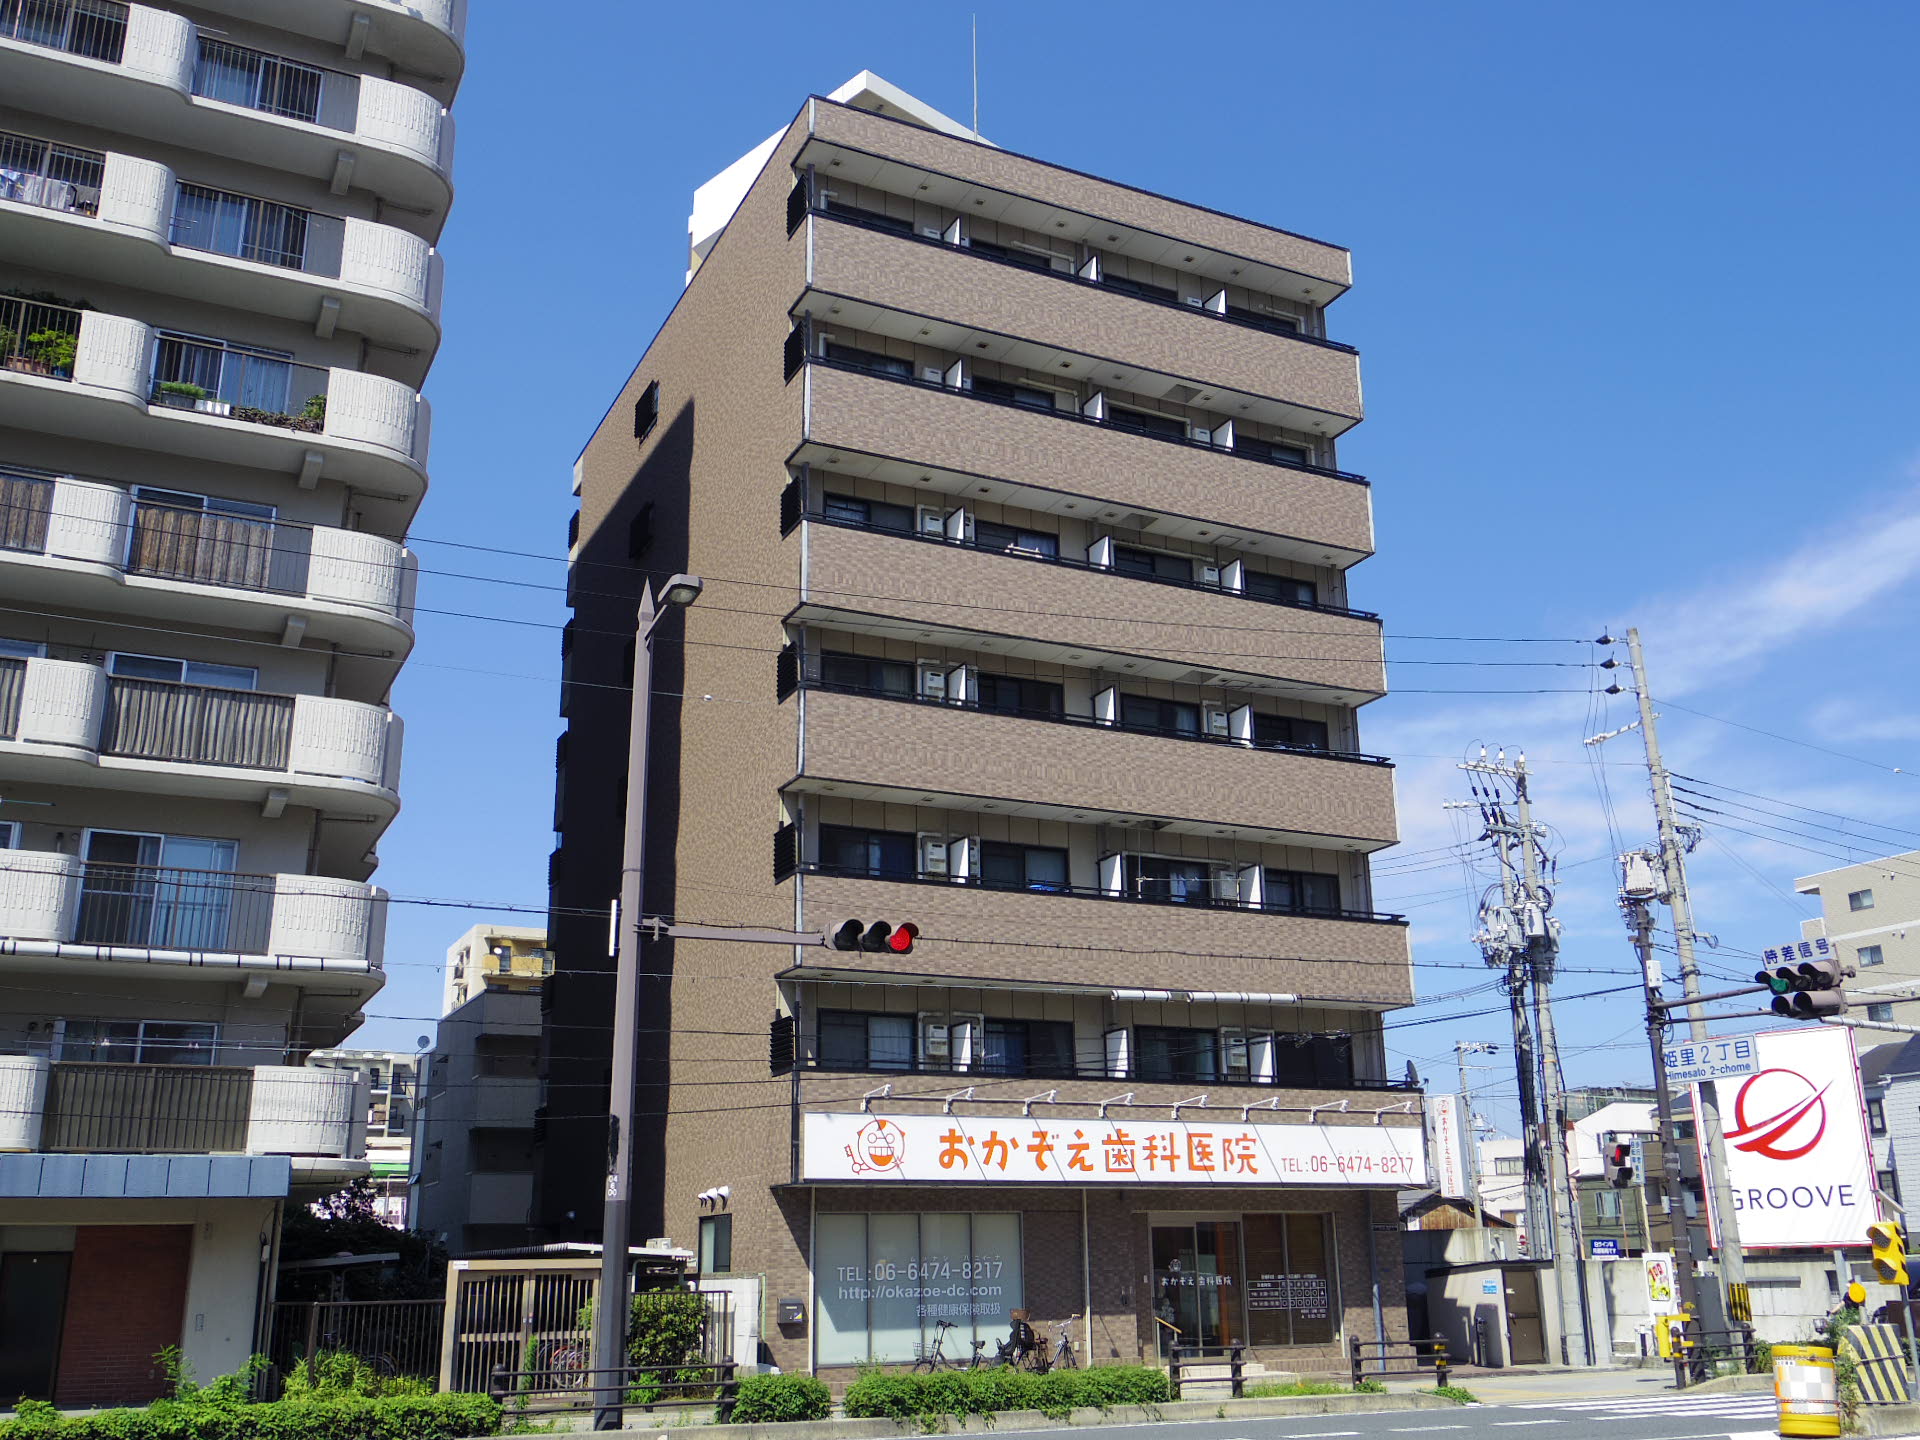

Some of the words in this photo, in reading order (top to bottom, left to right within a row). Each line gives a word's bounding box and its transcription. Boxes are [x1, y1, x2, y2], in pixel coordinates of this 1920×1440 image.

[1764, 938, 1830, 965] 時差信号
[1666, 1067, 1706, 1081] Himesato
[1710, 1063, 1751, 1076] 2-chome
[938, 1127, 1259, 1175] おかぞえ歯科医院
[1281, 1155, 1414, 1174] TEL:06-6474-8217
[1731, 1184, 1856, 1211] GROOVE
[836, 1261, 1004, 1282] TEL:06-6474-8217
[838, 1283, 1003, 1302] http://okazoe-dc.com
